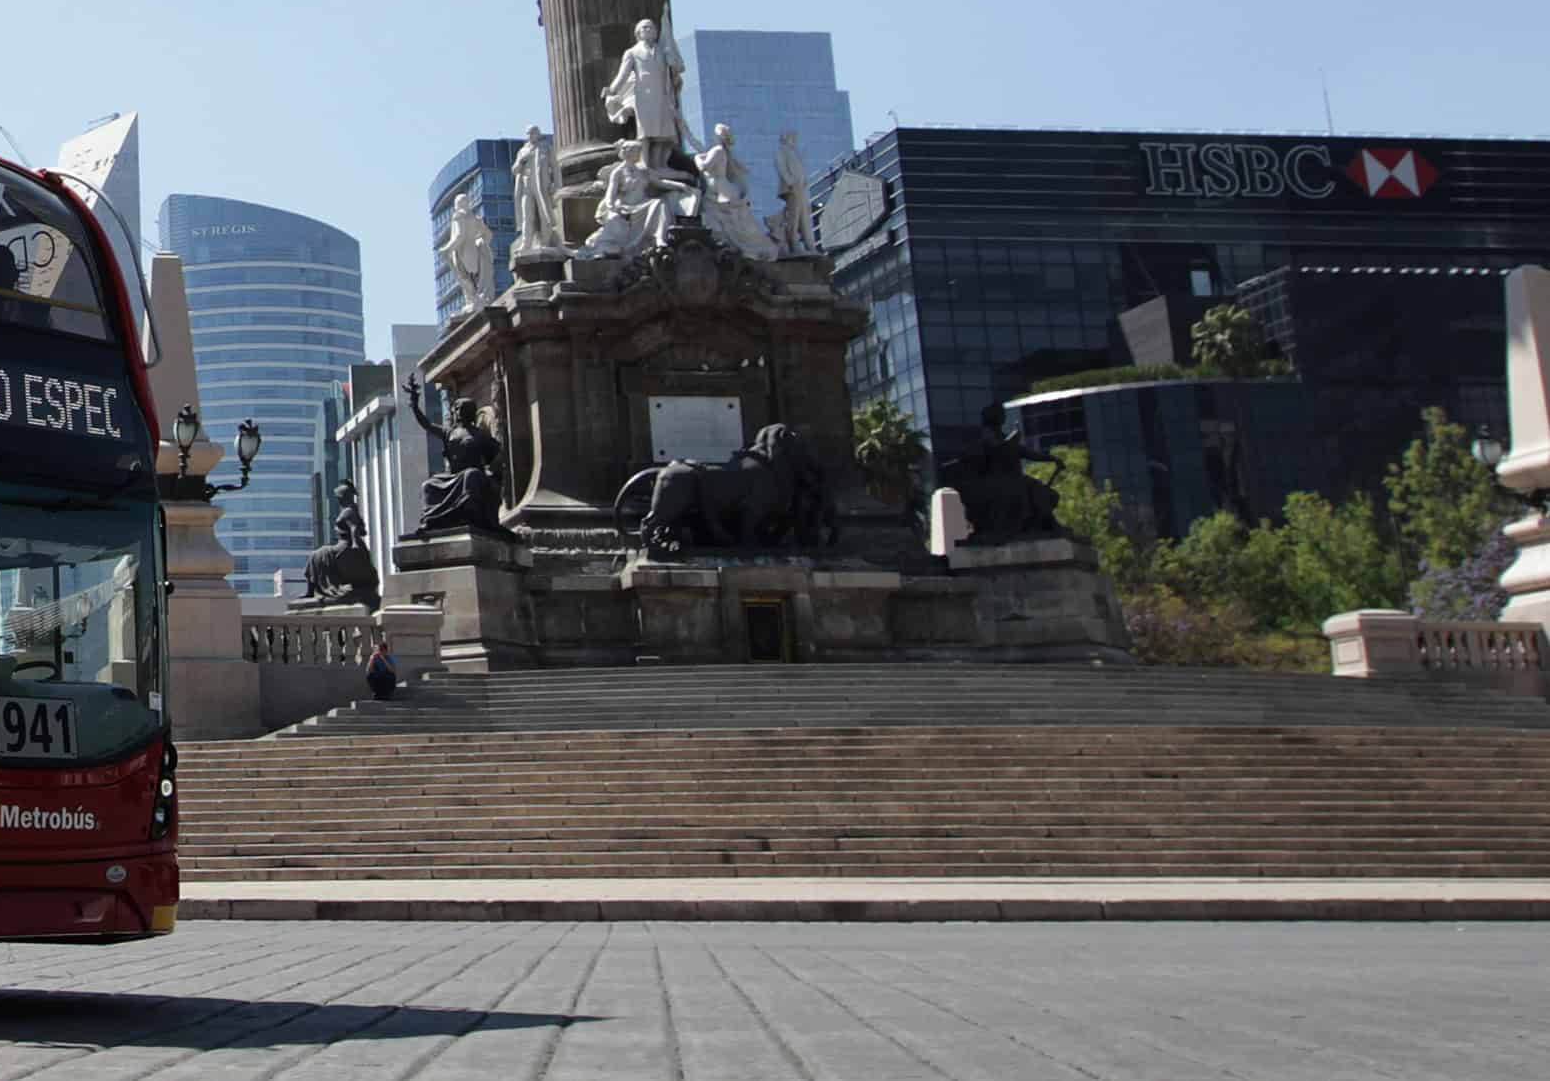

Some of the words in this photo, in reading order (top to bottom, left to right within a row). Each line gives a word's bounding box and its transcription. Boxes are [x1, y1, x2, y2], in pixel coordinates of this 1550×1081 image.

[1139, 142, 1336, 199] HSBC
[24, 373, 121, 438] ESPEC
[3, 700, 72, 754] 941
[0, 805, 96, 831] Metrobús
